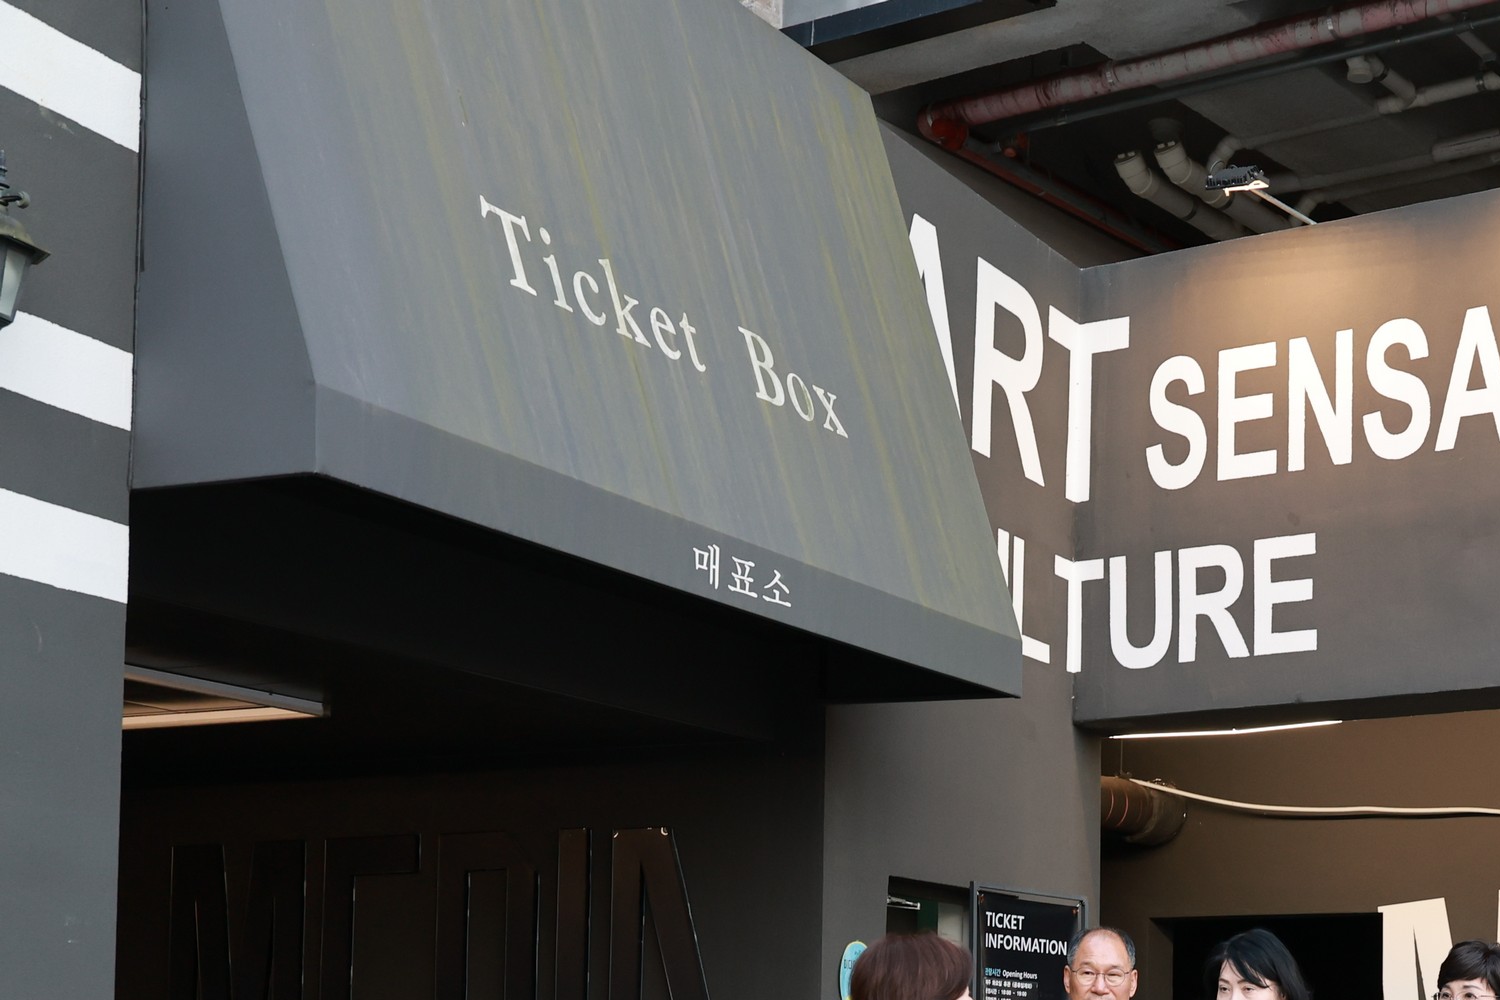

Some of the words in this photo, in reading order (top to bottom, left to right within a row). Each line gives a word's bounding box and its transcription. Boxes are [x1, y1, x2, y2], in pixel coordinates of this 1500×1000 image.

[479, 193, 707, 373] Ticket
[737, 325, 851, 440] Box
[692, 541, 793, 610] 매표소
[997, 528, 1320, 676] LTURE
[985, 911, 1025, 931] TICKET
[985, 932, 1068, 956] INFORMATION
[1002, 969, 1023, 980] Opening
[1022, 971, 1038, 980] Hours
